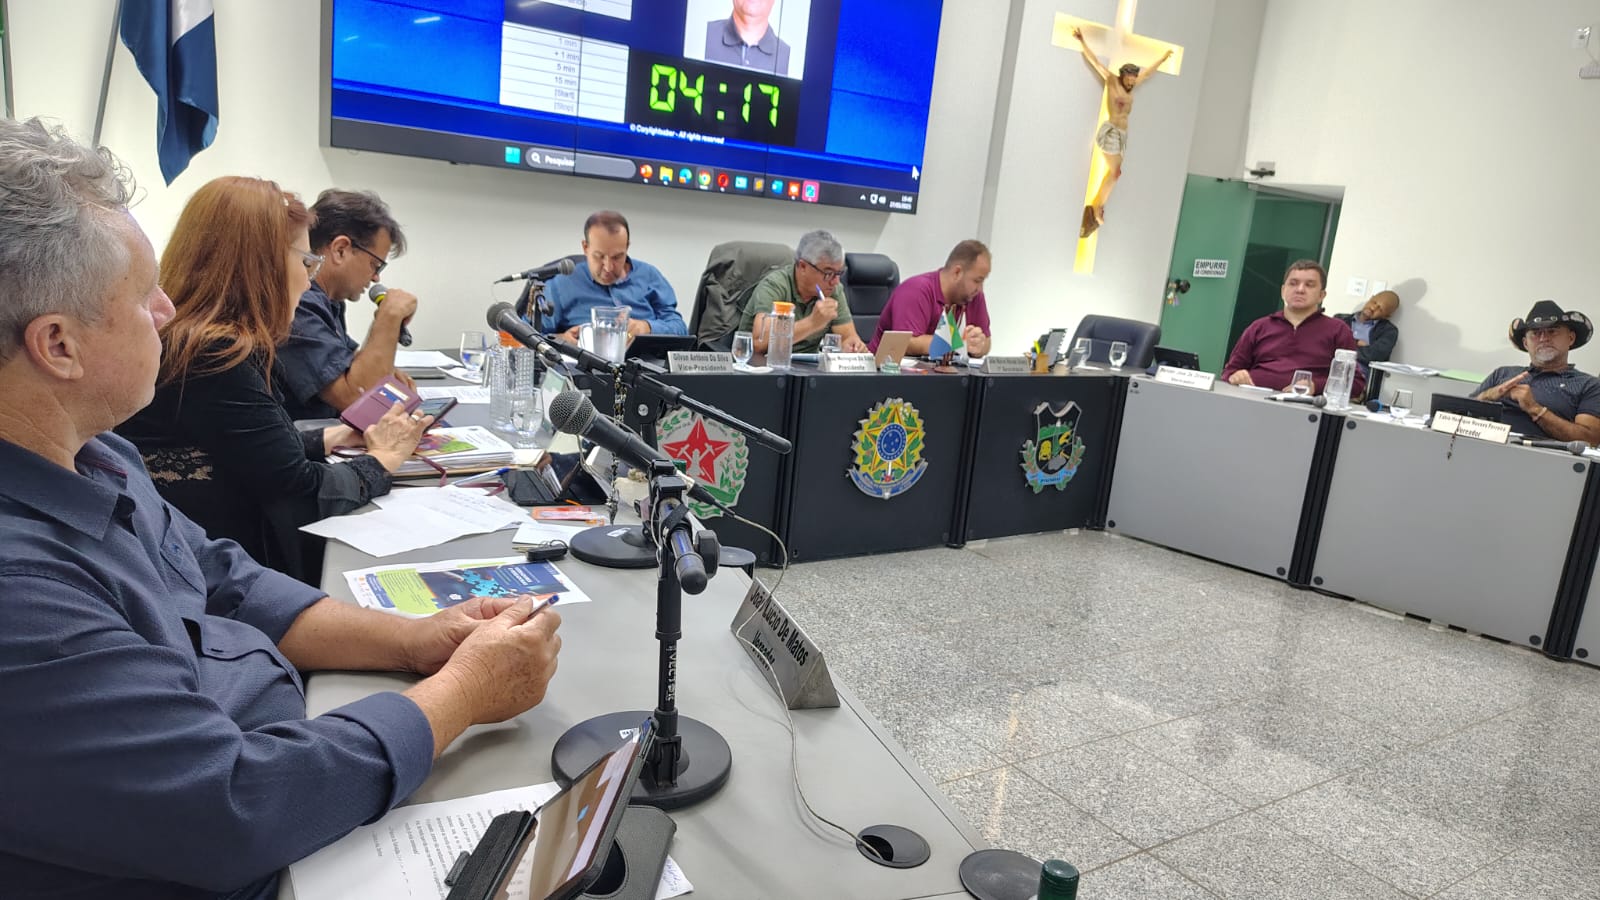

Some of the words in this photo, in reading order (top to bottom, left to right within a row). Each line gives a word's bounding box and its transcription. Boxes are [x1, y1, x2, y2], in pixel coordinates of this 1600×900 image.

[650, 63, 780, 128] 04:17
[1195, 260, 1227, 270] EMPURRE
[777, 618, 789, 642] De
[785, 628, 809, 666] Matos
